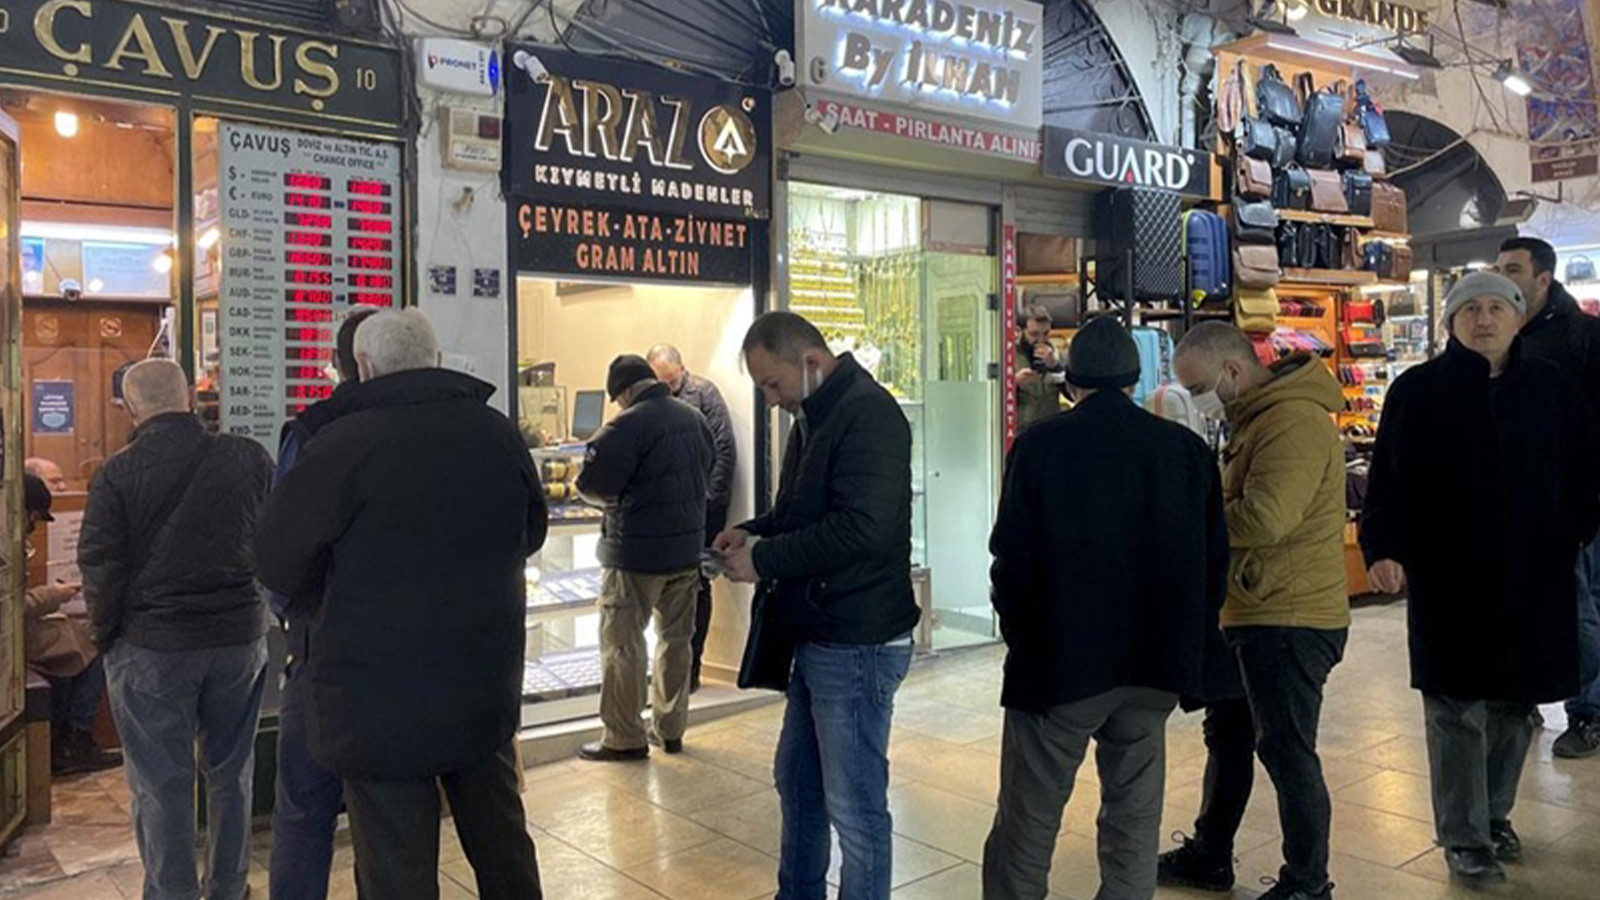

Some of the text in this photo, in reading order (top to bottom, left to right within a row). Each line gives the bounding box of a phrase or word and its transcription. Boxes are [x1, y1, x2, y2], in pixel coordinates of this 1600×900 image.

[34, 0, 340, 111] ÇAVUŞ
[357, 67, 376, 91] 10
[440, 57, 477, 71] PRONET
[843, 32, 896, 86] By
[230, 131, 291, 157] ÇAVUŞ
[535, 75, 694, 170] ARAZ
[826, 103, 879, 130] SAAT
[896, 116, 985, 149] PIRLANTA
[313, 153, 375, 170] CHANGE OFFICE
[1064, 137, 1191, 190] GUARD
[535, 164, 754, 206] KIYMETLİ MADENLER
[518, 204, 748, 248] ÇEYREK ATA ZİYNET
[576, 243, 699, 276] GRAM ALTIN
